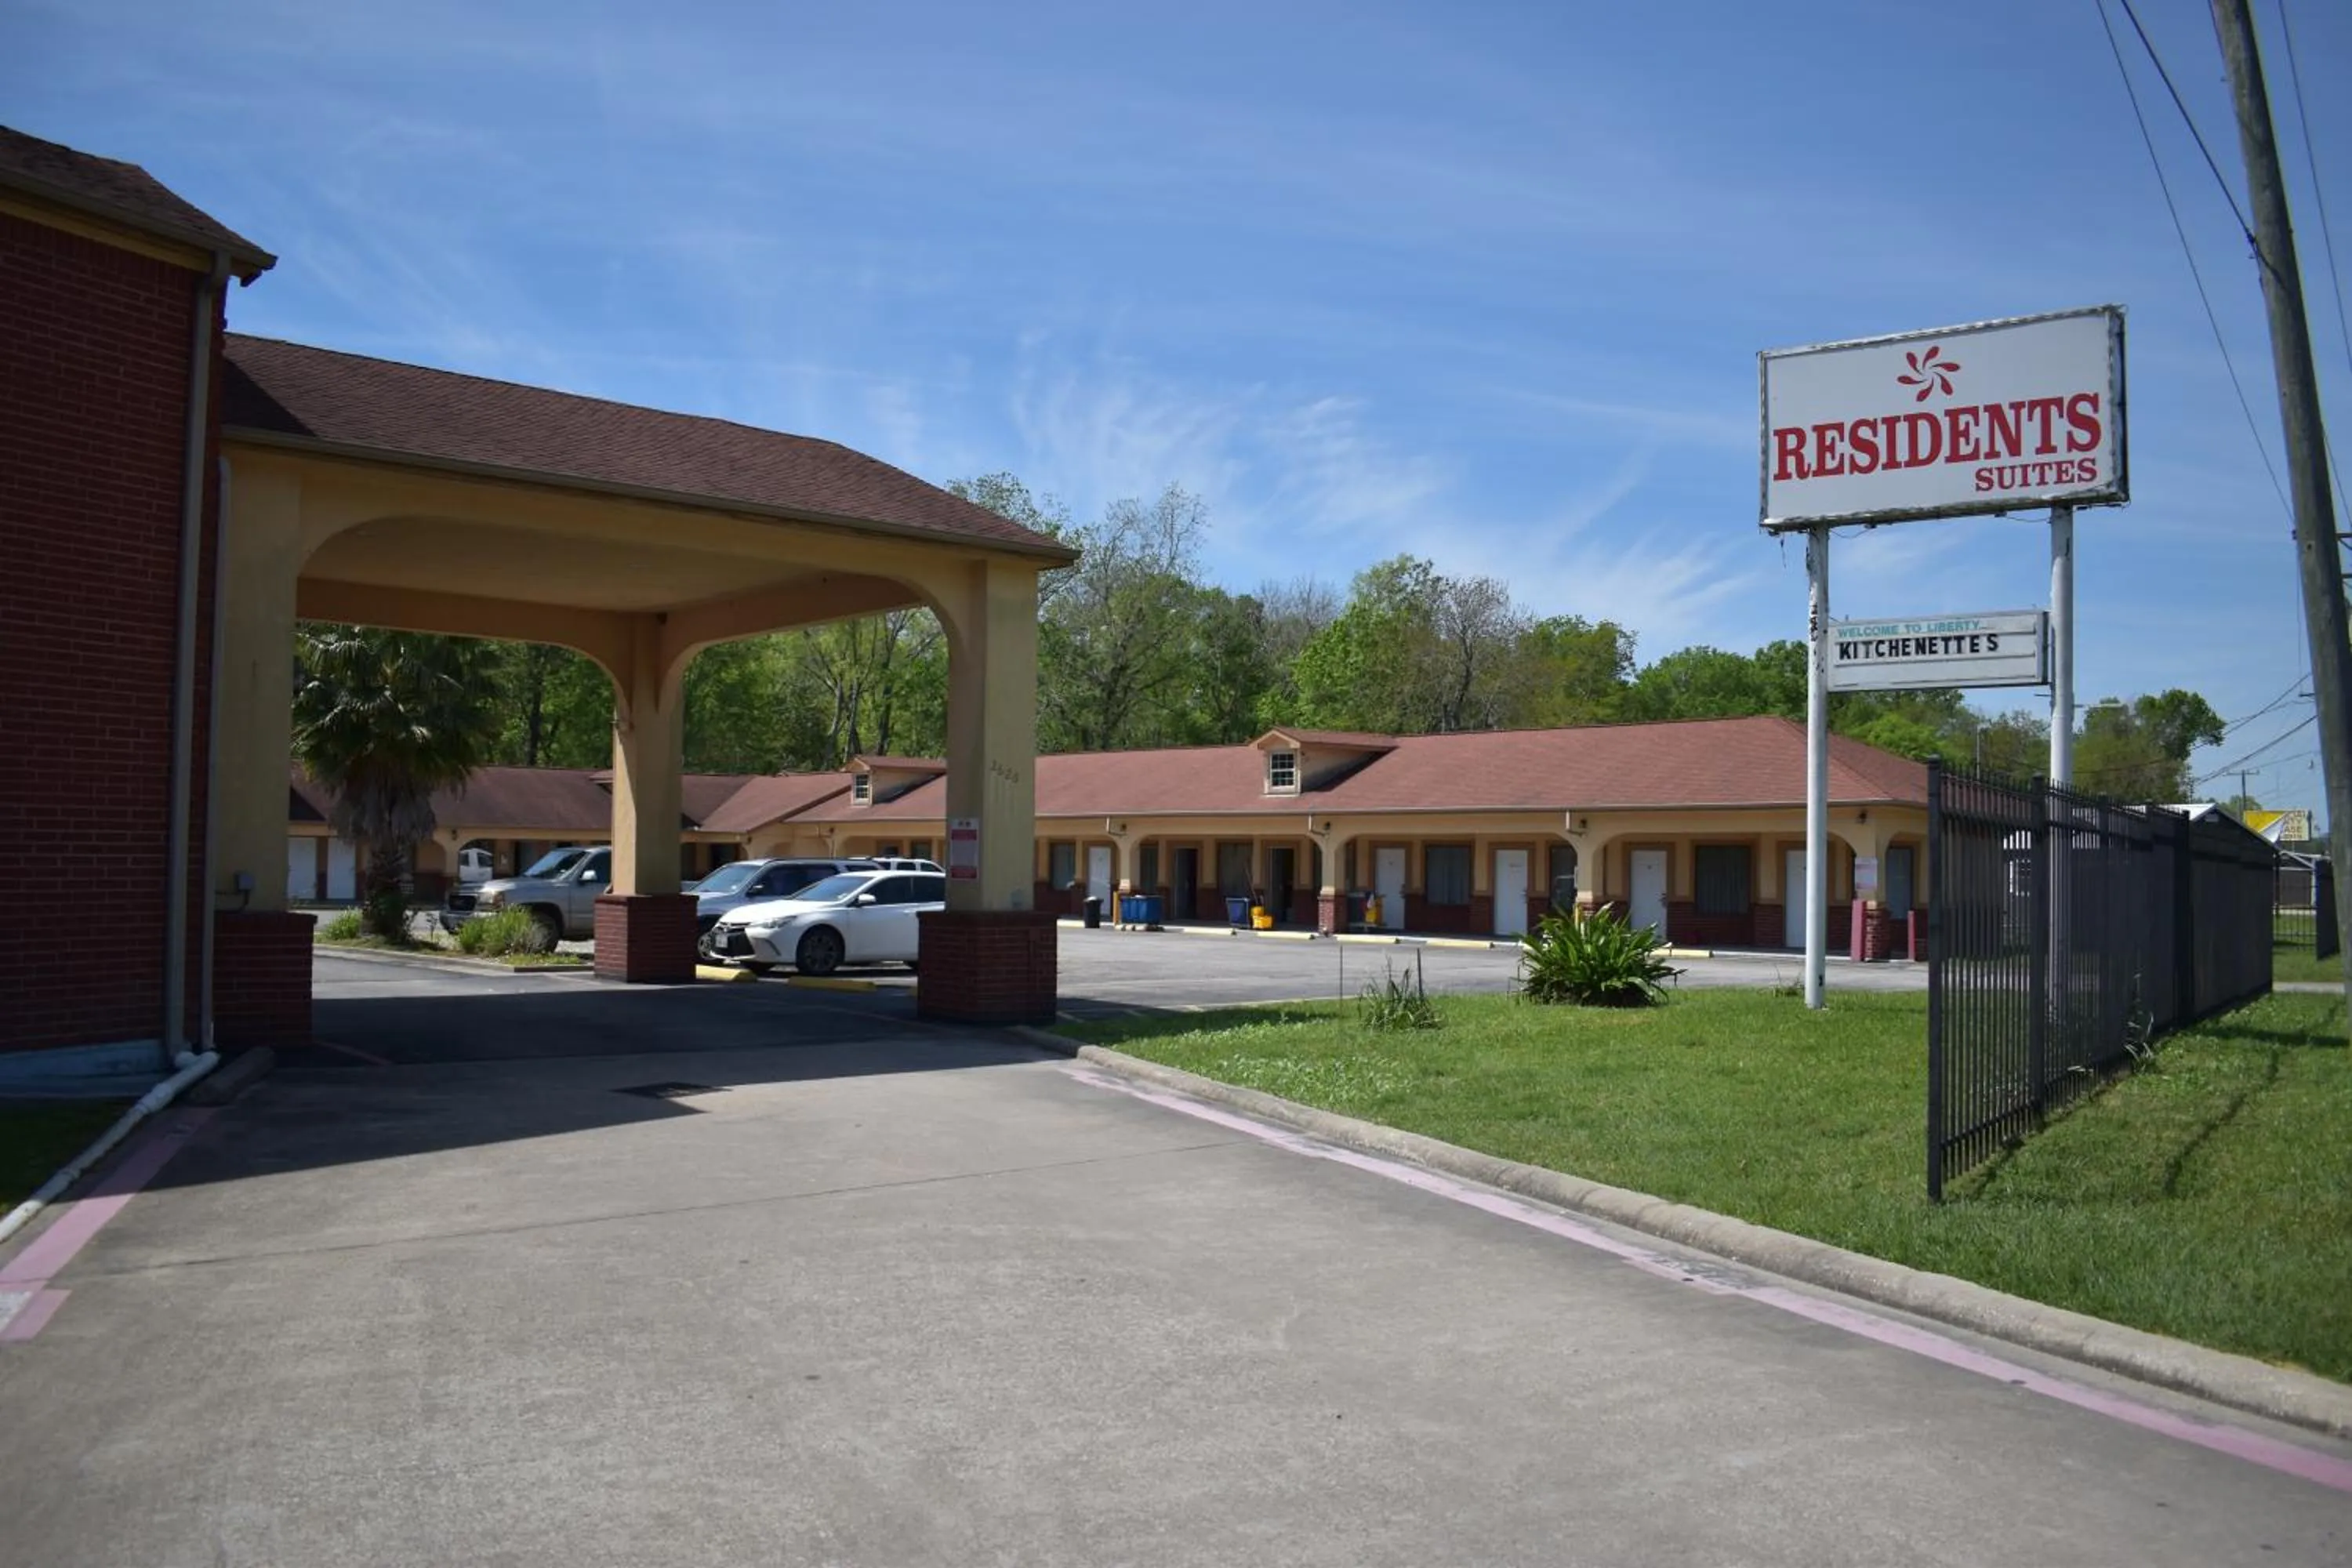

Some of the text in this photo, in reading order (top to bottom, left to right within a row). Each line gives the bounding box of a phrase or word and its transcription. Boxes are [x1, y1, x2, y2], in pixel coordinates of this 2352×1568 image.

[1773, 392, 2102, 481] RESIDENTS
[1975, 458, 2097, 492] SUITES
[1837, 620, 1980, 638] WELCOME TO LIBERTY
[1838, 633, 1998, 659] KITCHENETTES
